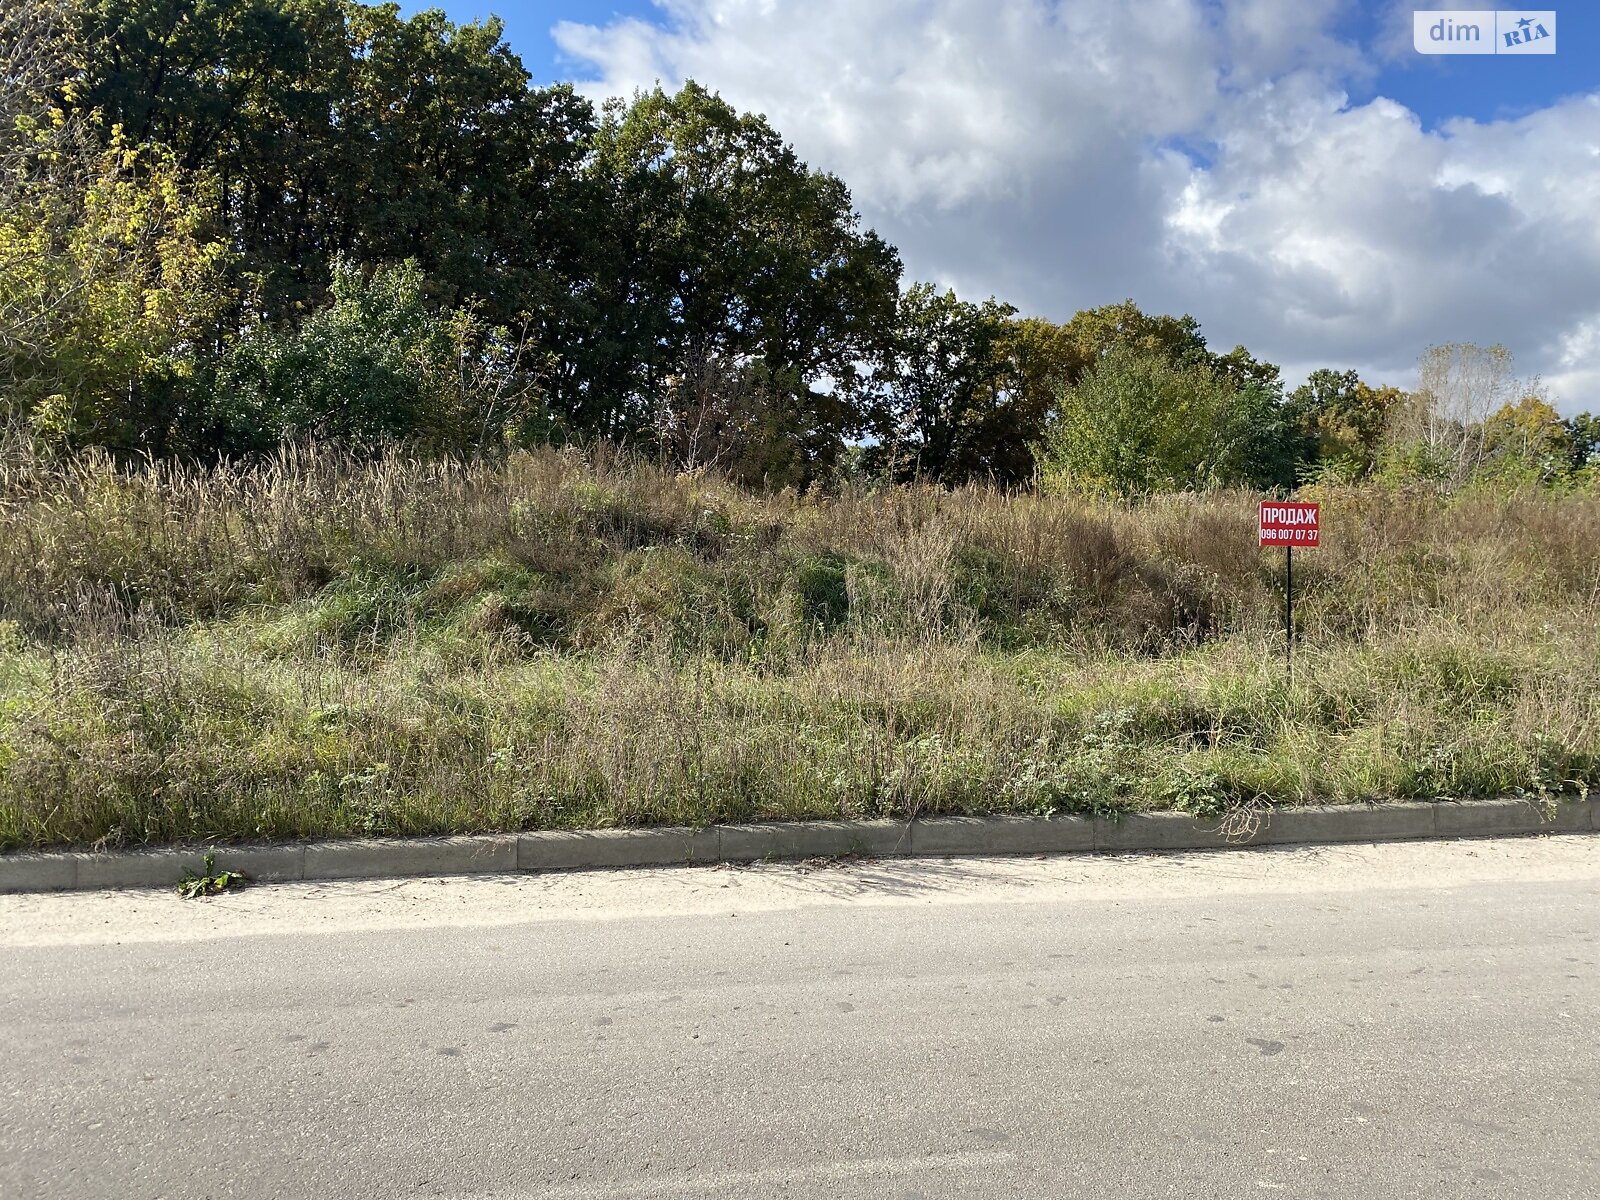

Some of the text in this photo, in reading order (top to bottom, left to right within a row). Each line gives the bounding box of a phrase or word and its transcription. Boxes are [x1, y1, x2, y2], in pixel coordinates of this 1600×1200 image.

[1262, 507, 1317, 525] ПРОДАЖ
[1261, 528, 1318, 541] 096 007 07 37
